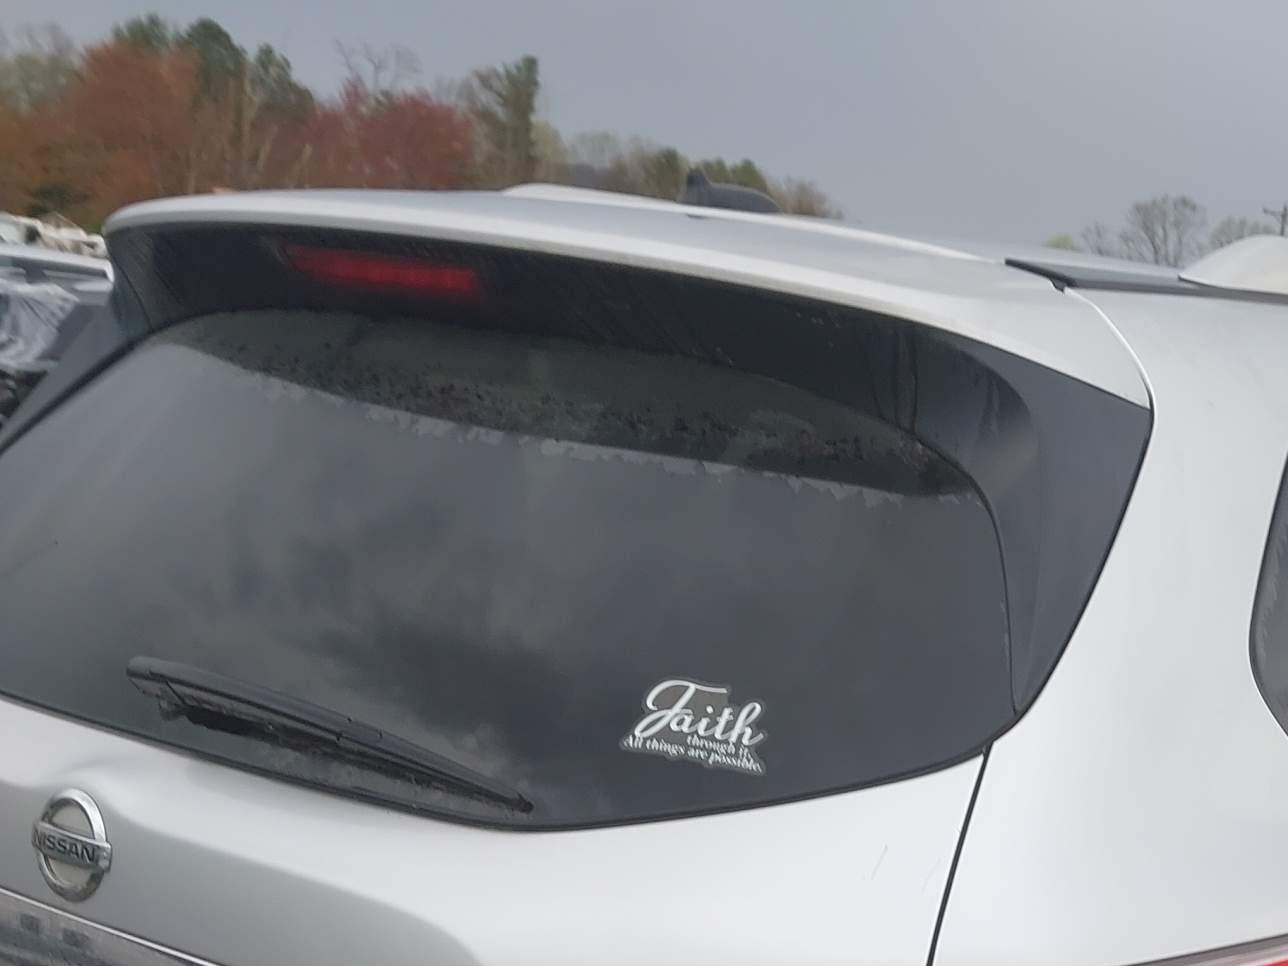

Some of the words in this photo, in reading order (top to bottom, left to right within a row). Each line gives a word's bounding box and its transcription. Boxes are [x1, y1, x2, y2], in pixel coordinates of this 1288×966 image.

[634, 679, 765, 746] Faith
[623, 734, 644, 749] All
[645, 738, 686, 757] things
[687, 747, 709, 760] are
[686, 734, 736, 756] through
[32, 826, 96, 863] NISSAN
